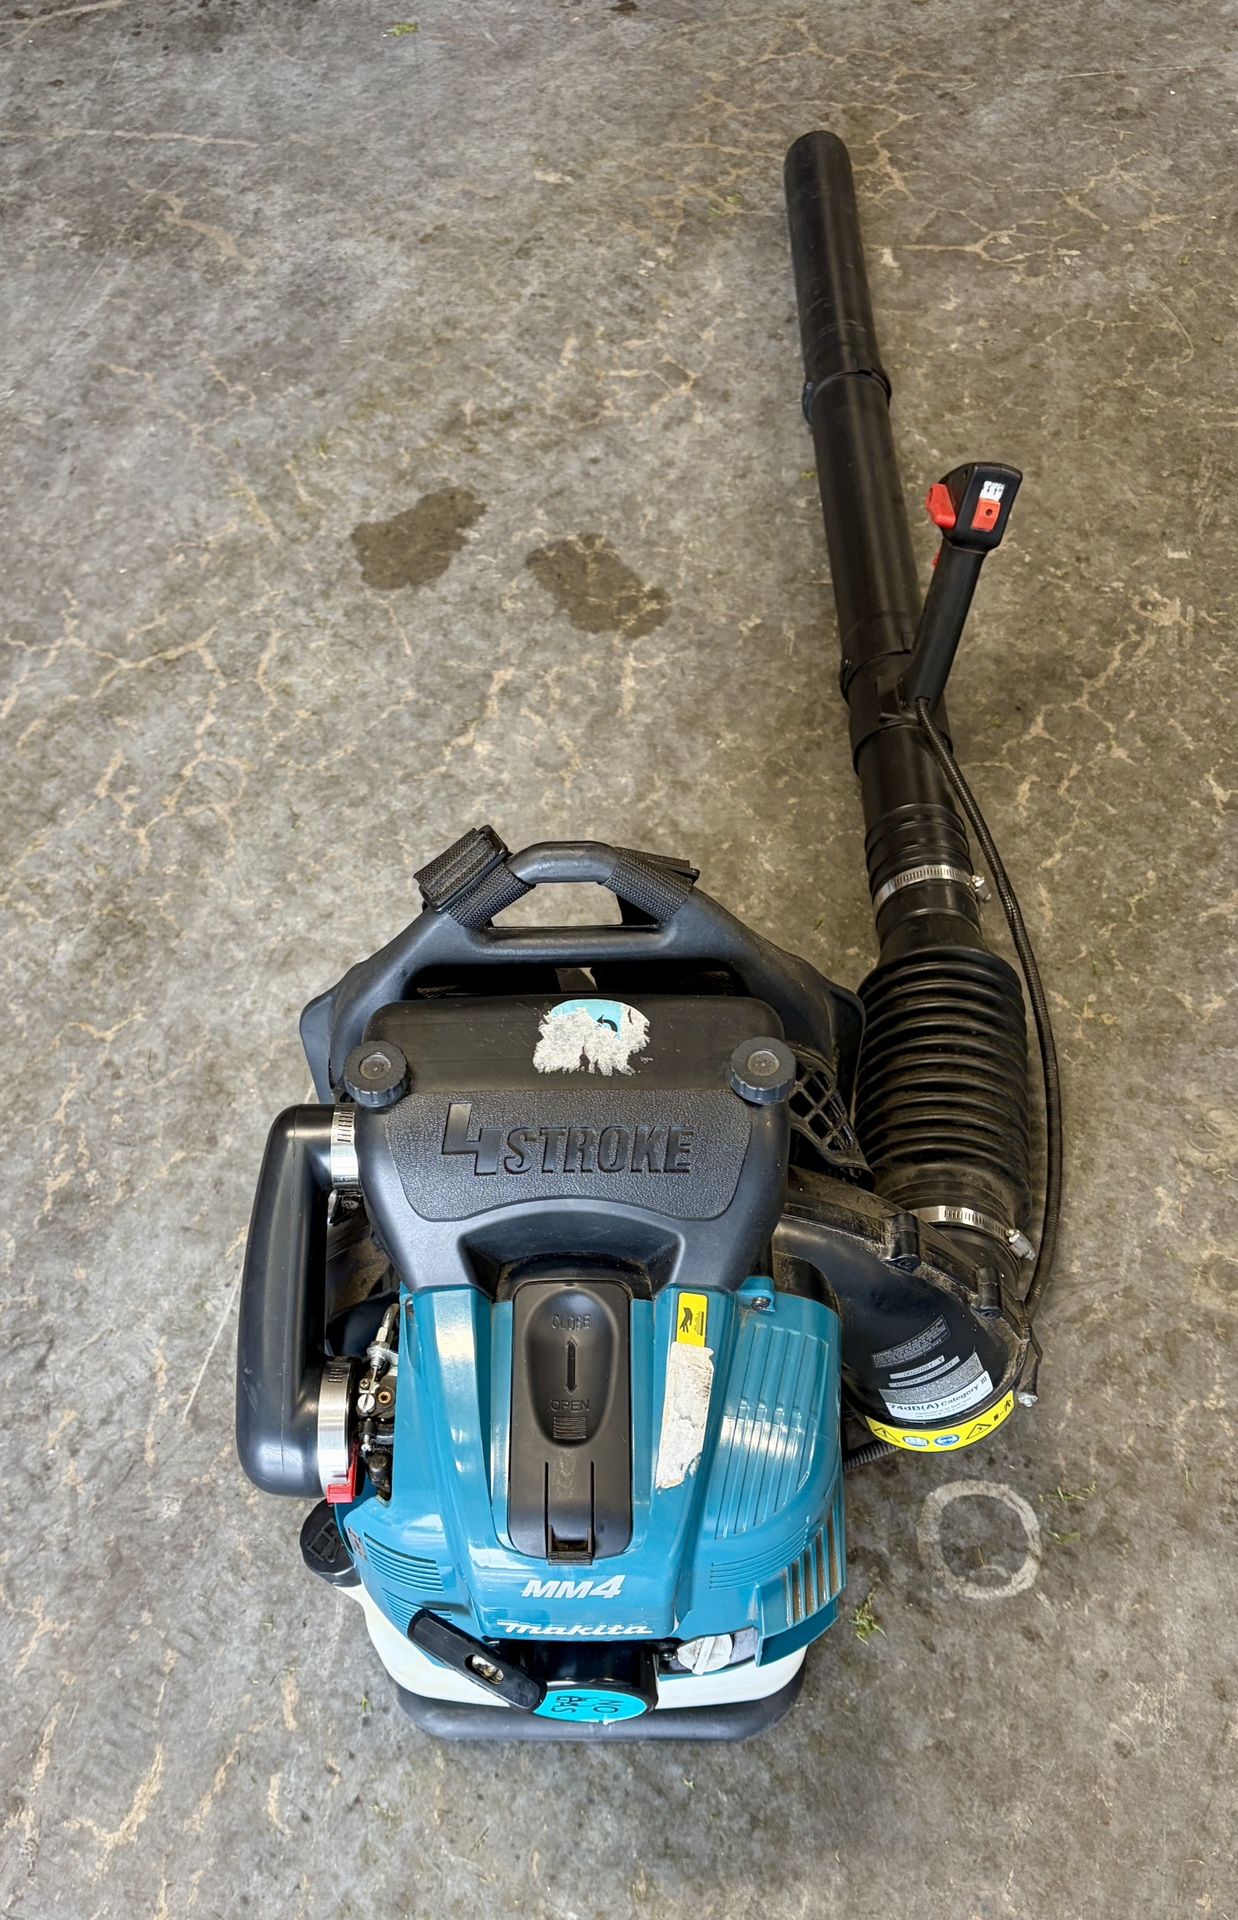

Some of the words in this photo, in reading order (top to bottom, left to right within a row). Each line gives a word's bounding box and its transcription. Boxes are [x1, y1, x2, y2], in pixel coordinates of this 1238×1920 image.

[552, 1313, 591, 1331] CLOSE
[941, 1384, 979, 1406] Category
[550, 1399, 590, 1413] OPEN
[521, 1575, 626, 1598] MM4
